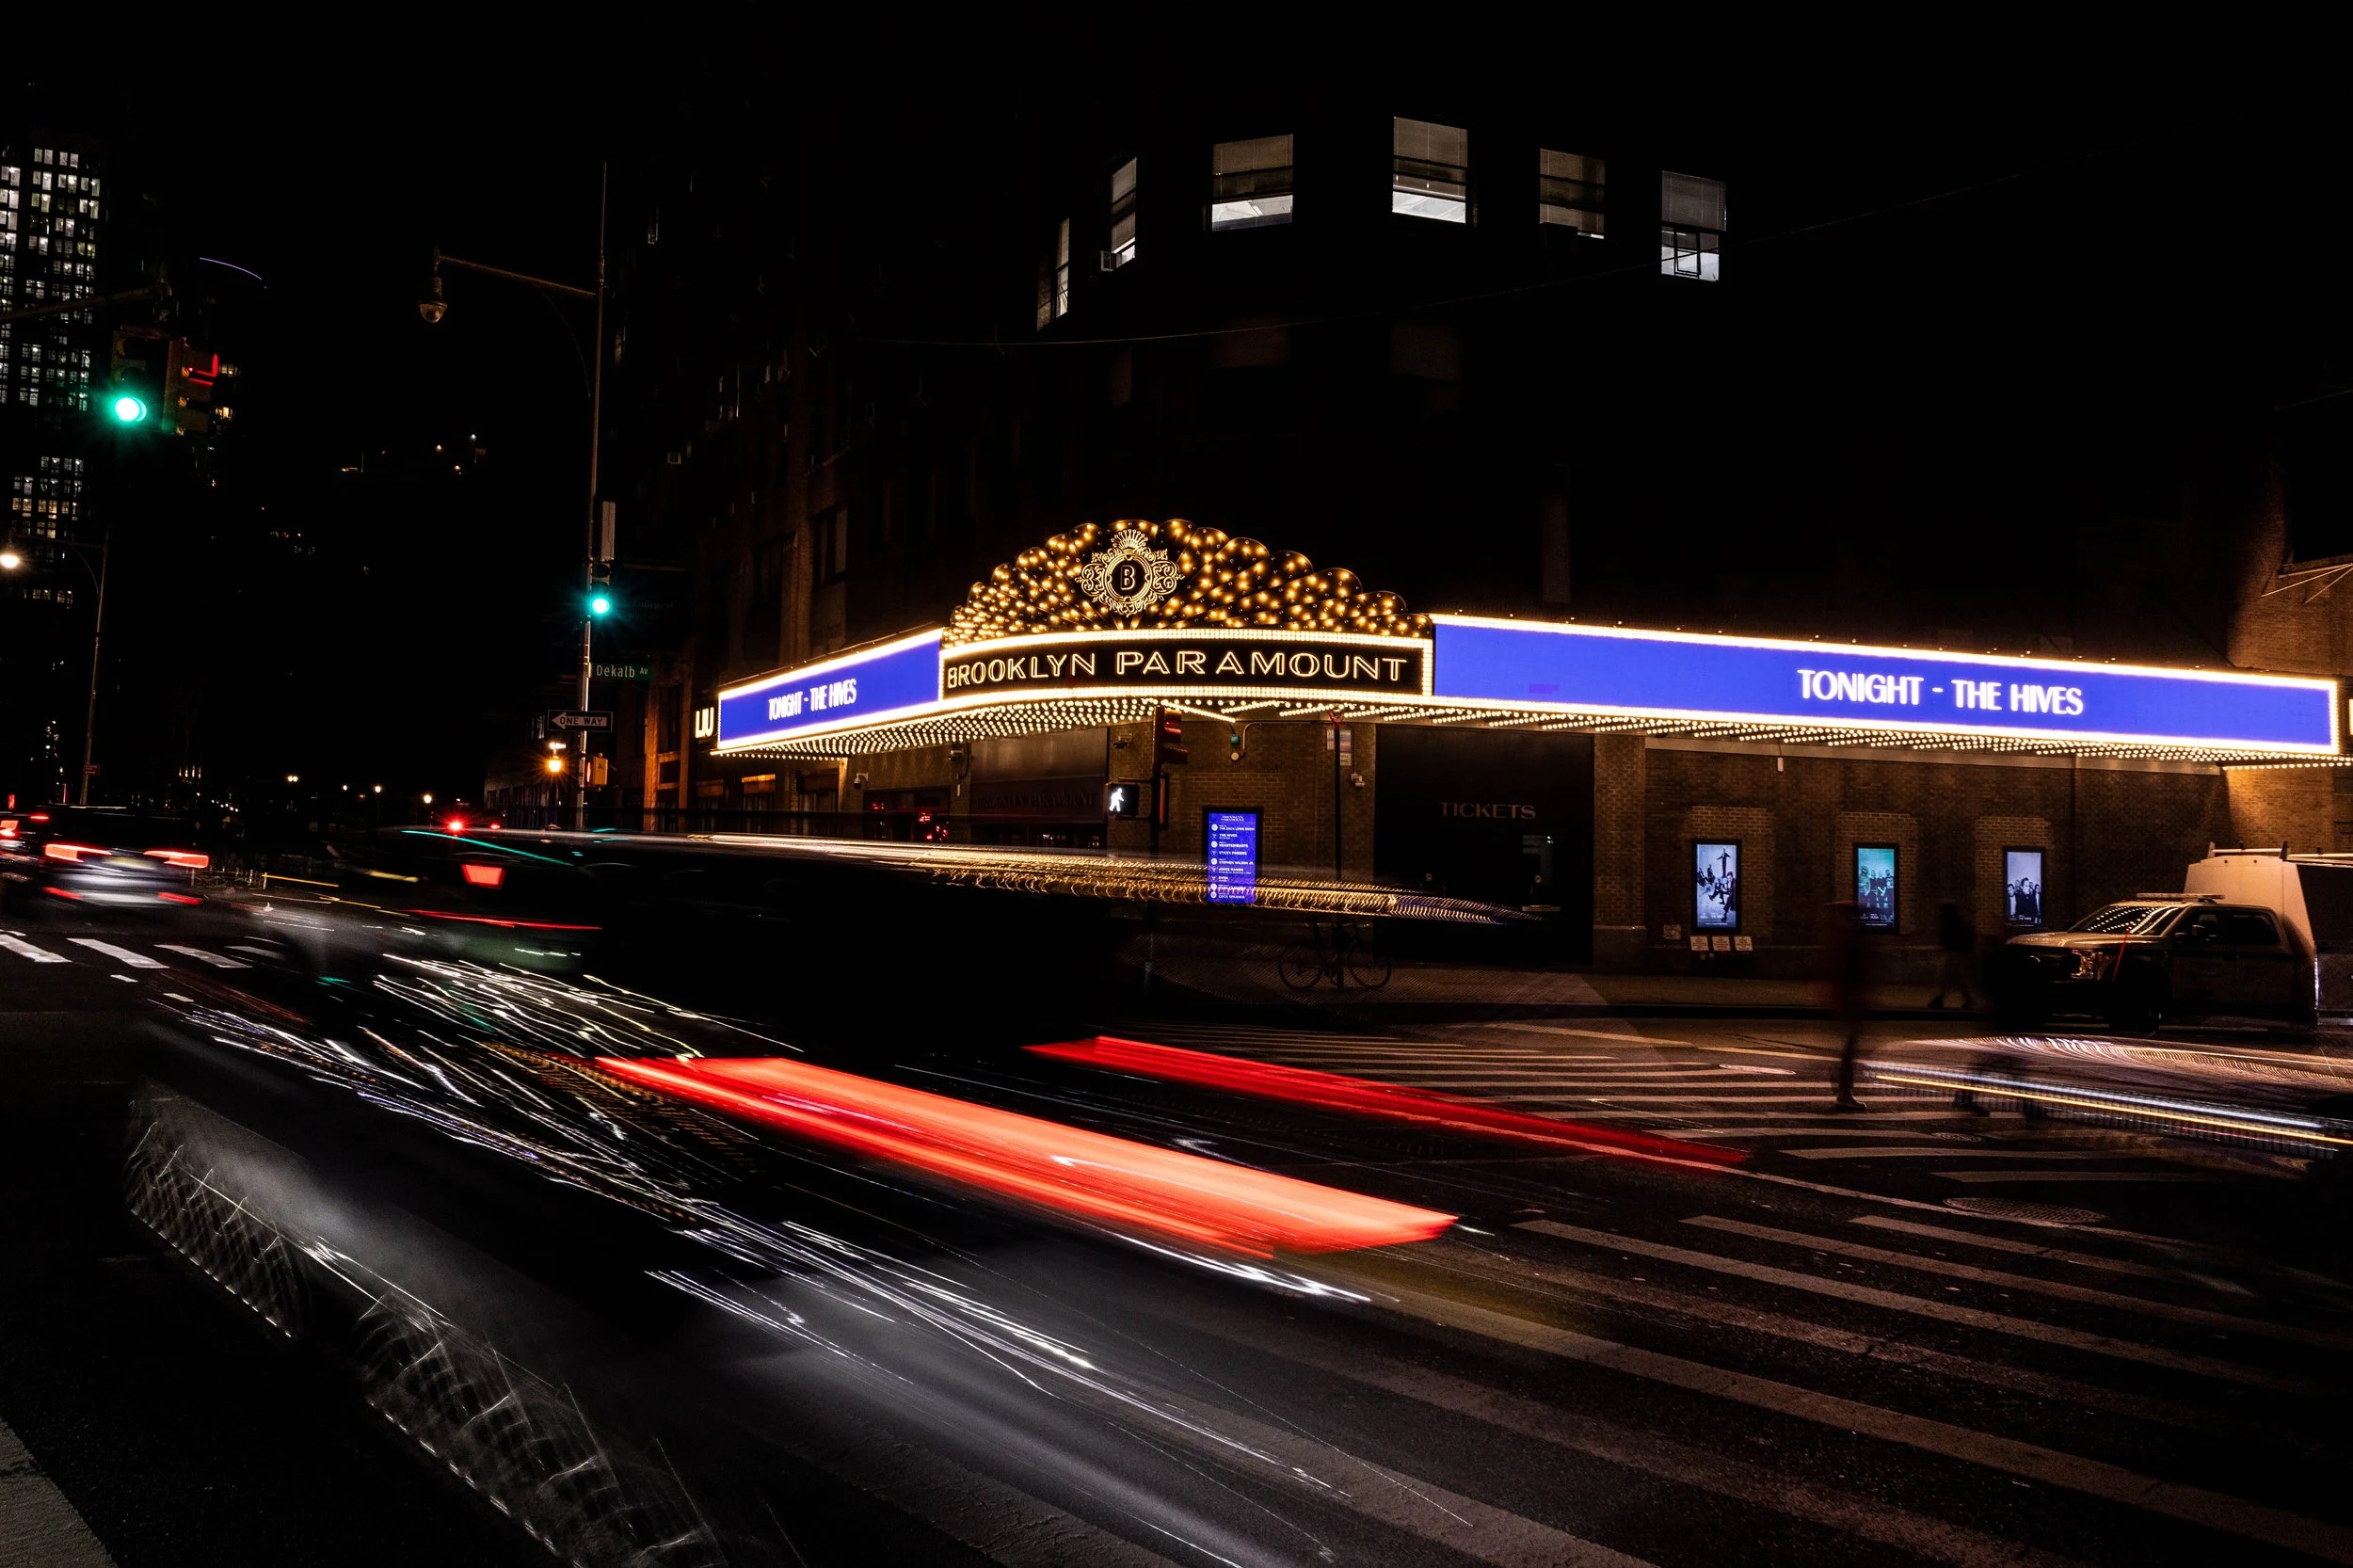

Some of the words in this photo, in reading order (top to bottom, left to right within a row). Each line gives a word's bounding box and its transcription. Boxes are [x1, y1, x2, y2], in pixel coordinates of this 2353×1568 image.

[1120, 566, 1135, 590] B
[596, 664, 635, 678] Dekalb
[947, 652, 1096, 689] BROOKLYN
[1116, 651, 1408, 681] PARAMOUNT
[768, 691, 803, 721] TONIGHT
[809, 684, 828, 712] THE
[829, 678, 857, 709] HIVES
[1797, 669, 1925, 706] TONIGHT
[1951, 680, 2003, 712] THE
[2010, 684, 2085, 716] HIVES
[559, 716, 579, 726] ONE
[584, 716, 603, 726] WAY
[1439, 801, 1537, 820] TICKETS
